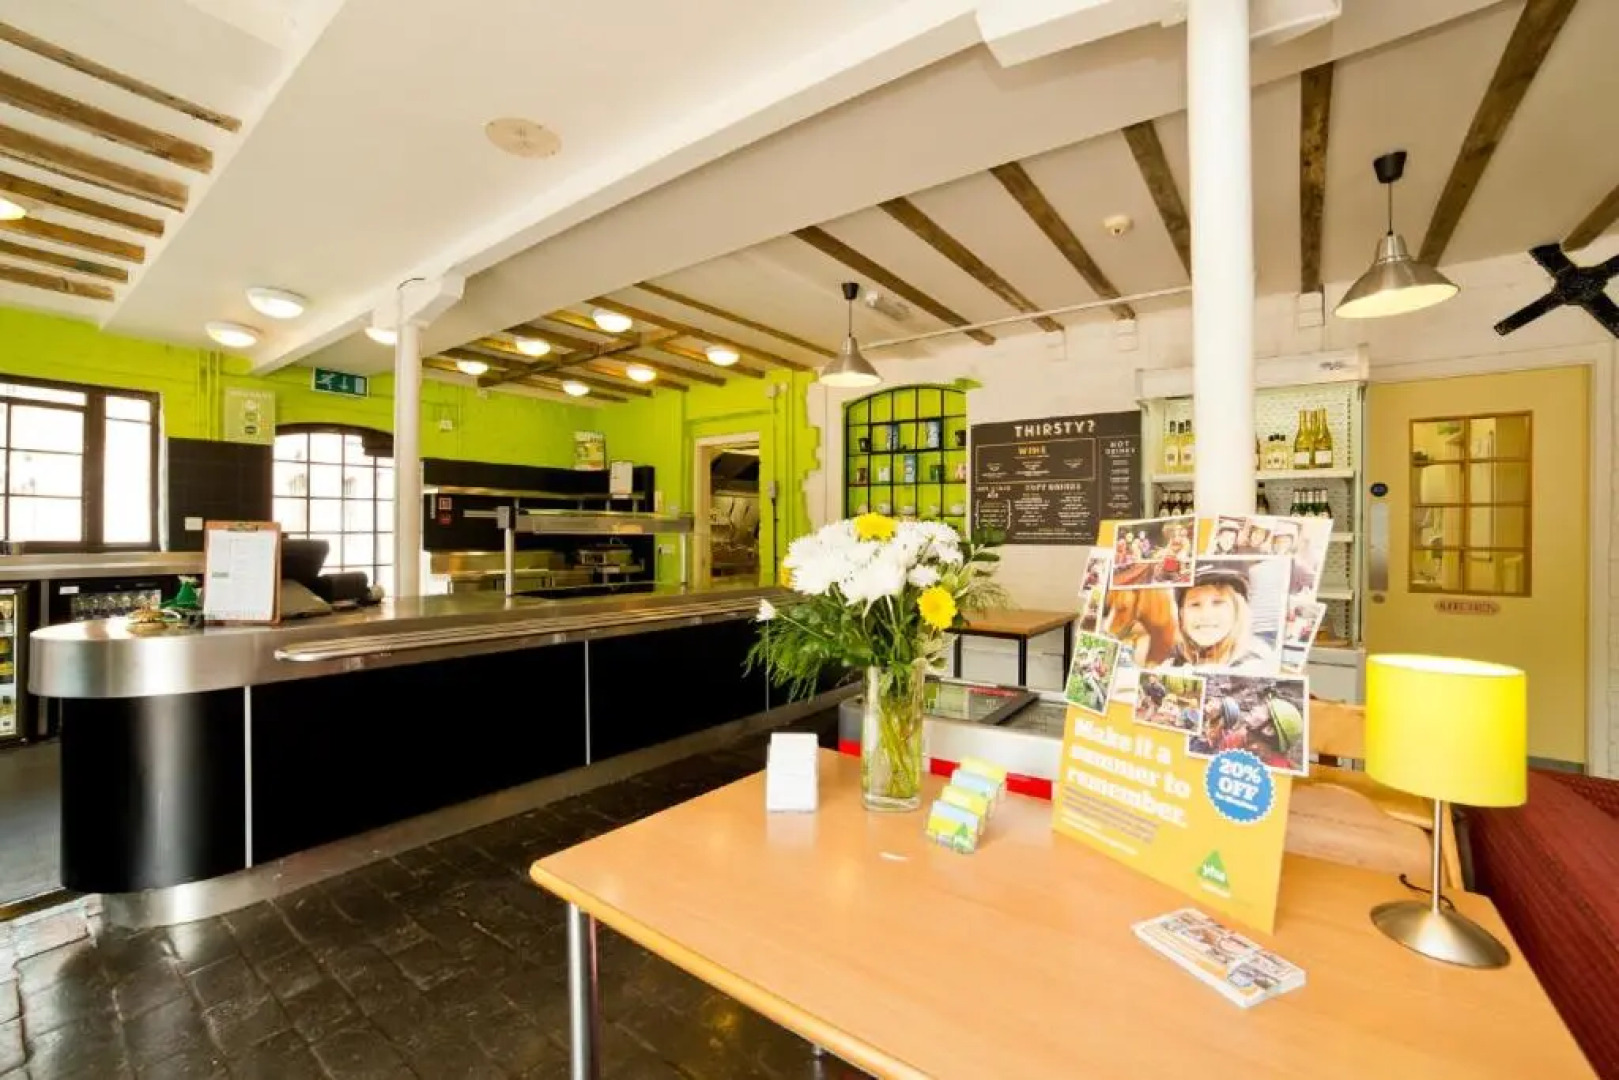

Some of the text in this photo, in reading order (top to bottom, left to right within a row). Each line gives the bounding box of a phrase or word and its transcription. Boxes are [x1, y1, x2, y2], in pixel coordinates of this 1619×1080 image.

[1014, 420, 1096, 437] THIRSTY?
[1018, 446, 1046, 455] WINE
[1074, 718, 1131, 751] Make
[1219, 759, 1261, 784] 20%
[1163, 772, 1191, 798] to
[1218, 776, 1260, 800] OFF
